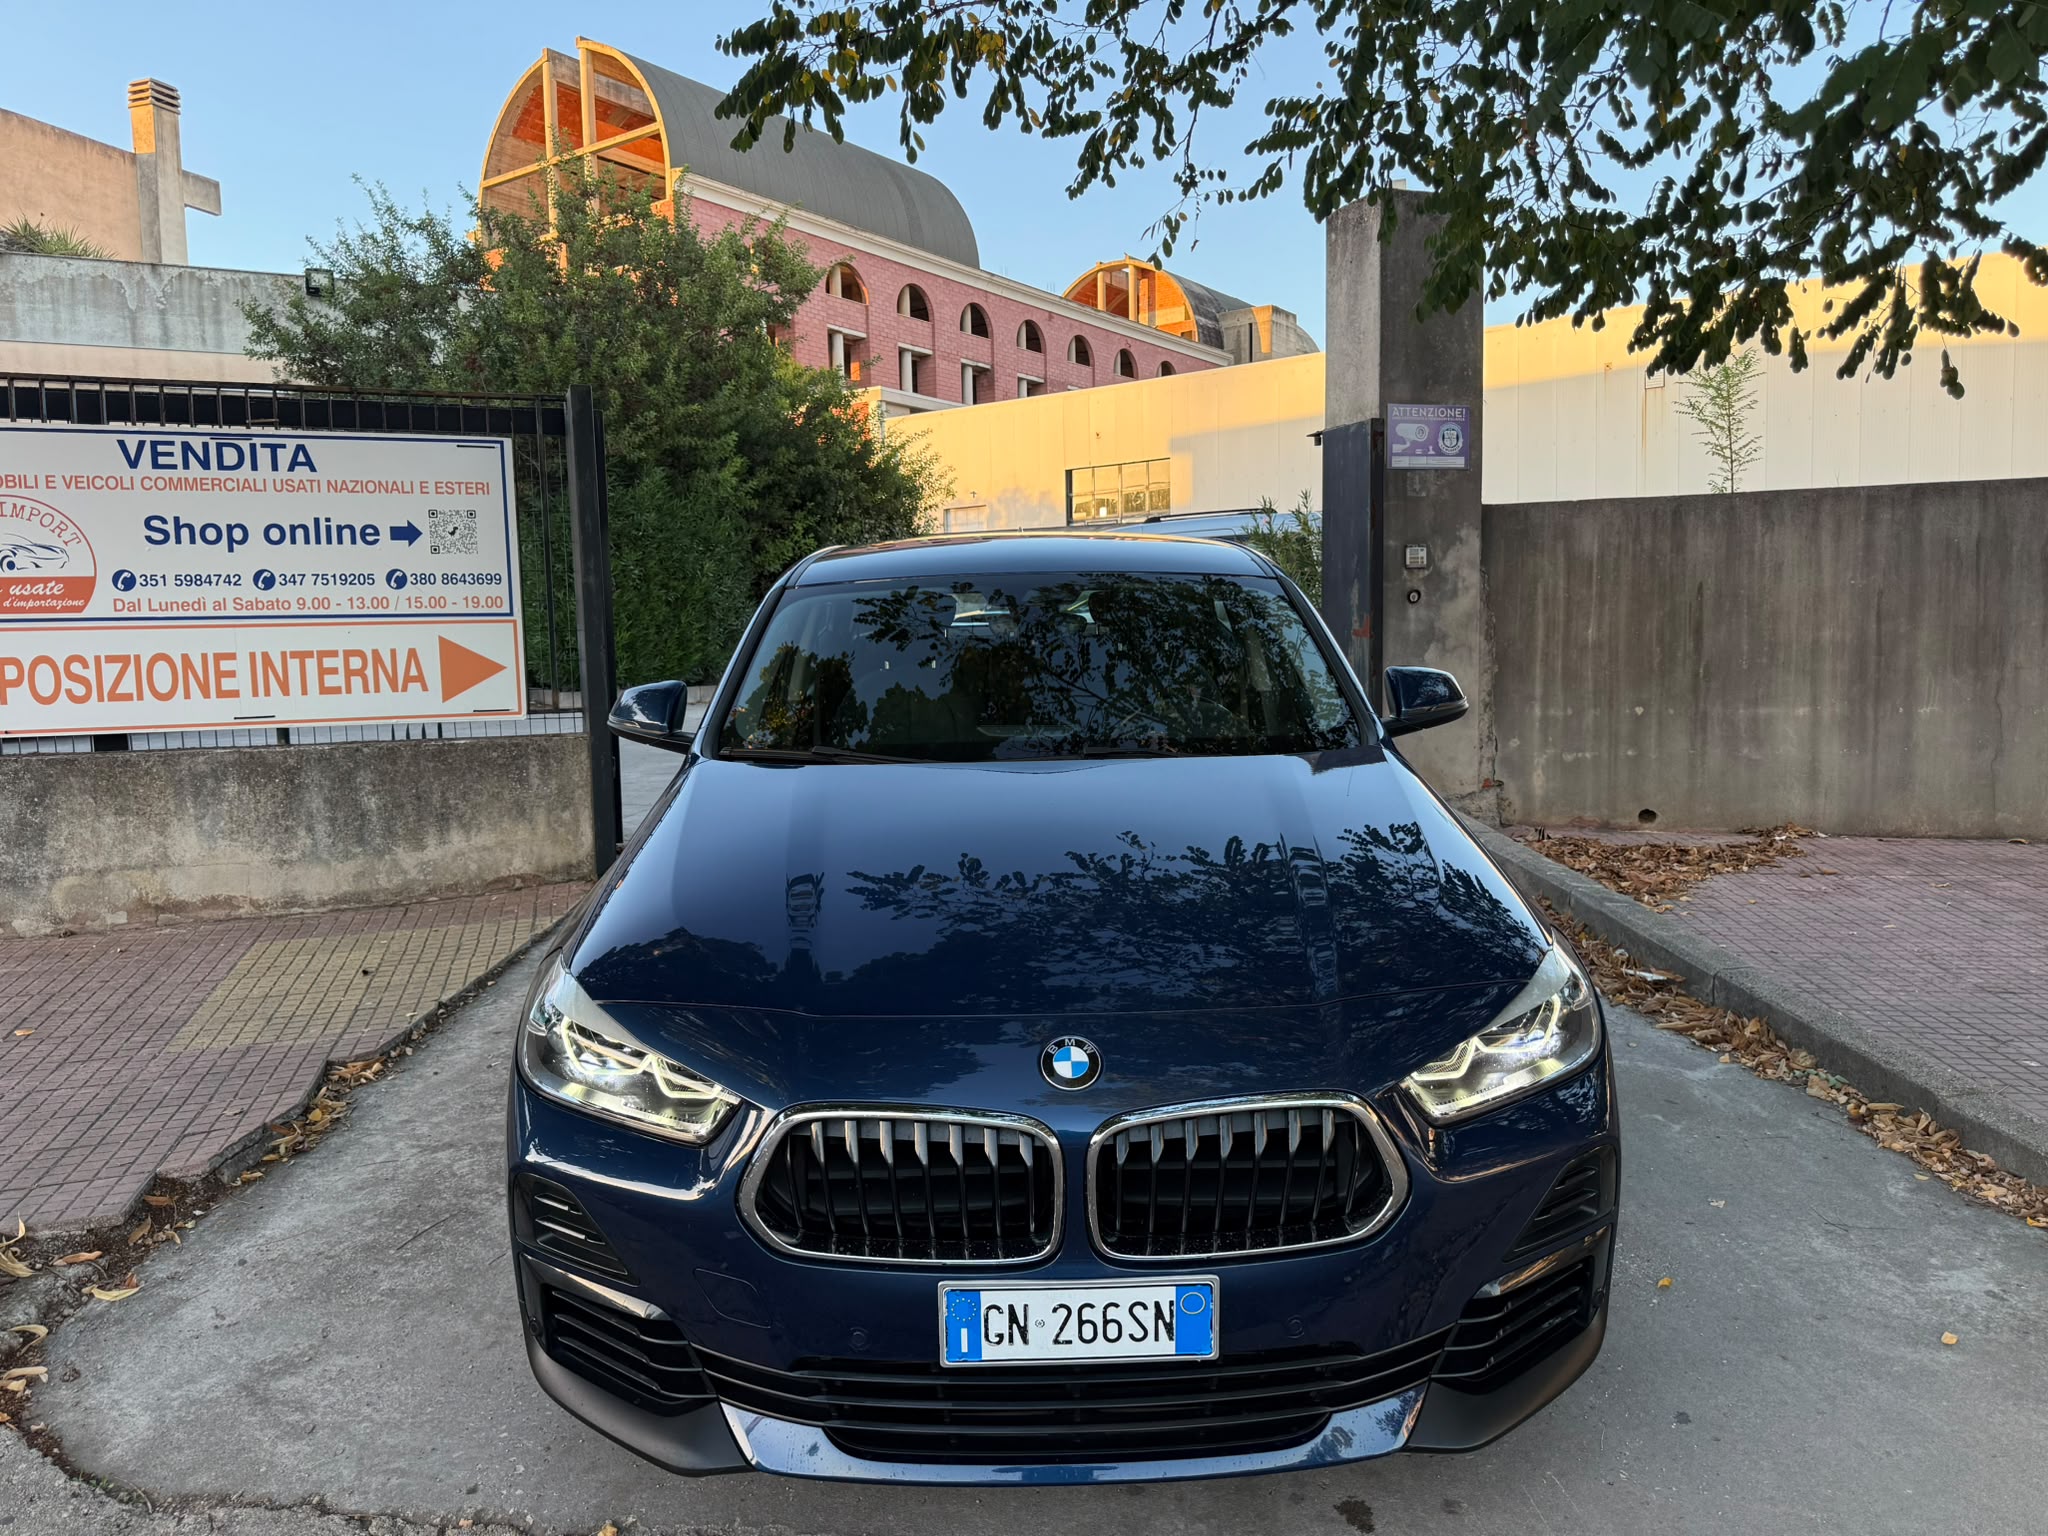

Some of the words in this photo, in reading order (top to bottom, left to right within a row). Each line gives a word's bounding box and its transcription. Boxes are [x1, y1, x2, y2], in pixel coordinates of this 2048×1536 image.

[1392, 407, 1466, 418] ATTENZIONE!
[116, 439, 318, 473] VENDITA
[0, 474, 39, 490] BILI
[45, 474, 57, 490] E
[62, 475, 135, 491] VEICOLI
[140, 476, 267, 493] COMMERCIALI
[272, 478, 322, 494] USATI
[326, 479, 414, 495] NAZIONALI
[419, 481, 430, 495] E
[434, 481, 491, 496] ESTERI
[143, 515, 250, 553] Shop
[263, 517, 381, 547] online
[9, 580, 65, 596] usate
[139, 574, 168, 588] 351
[174, 573, 243, 587] 5984742
[278, 573, 306, 587] 347
[311, 573, 376, 586] 7519205
[410, 573, 437, 586] 380
[441, 573, 502, 586] 8643699
[3, 596, 86, 610] d'importazione
[113, 598, 142, 613] Dal
[148, 596, 207, 613] Lunedì
[212, 597, 228, 611] al
[233, 597, 292, 612] Sabato
[297, 597, 331, 611] 9.00
[347, 596, 391, 610] 13.00
[406, 596, 448, 609] 15.00
[463, 595, 504, 609] 19.00
[249, 646, 430, 698] INTERNA
[1047, 1037, 1095, 1055] BMW
[983, 1303, 1029, 1346] GN
[1052, 1300, 1175, 1346] 266SN
